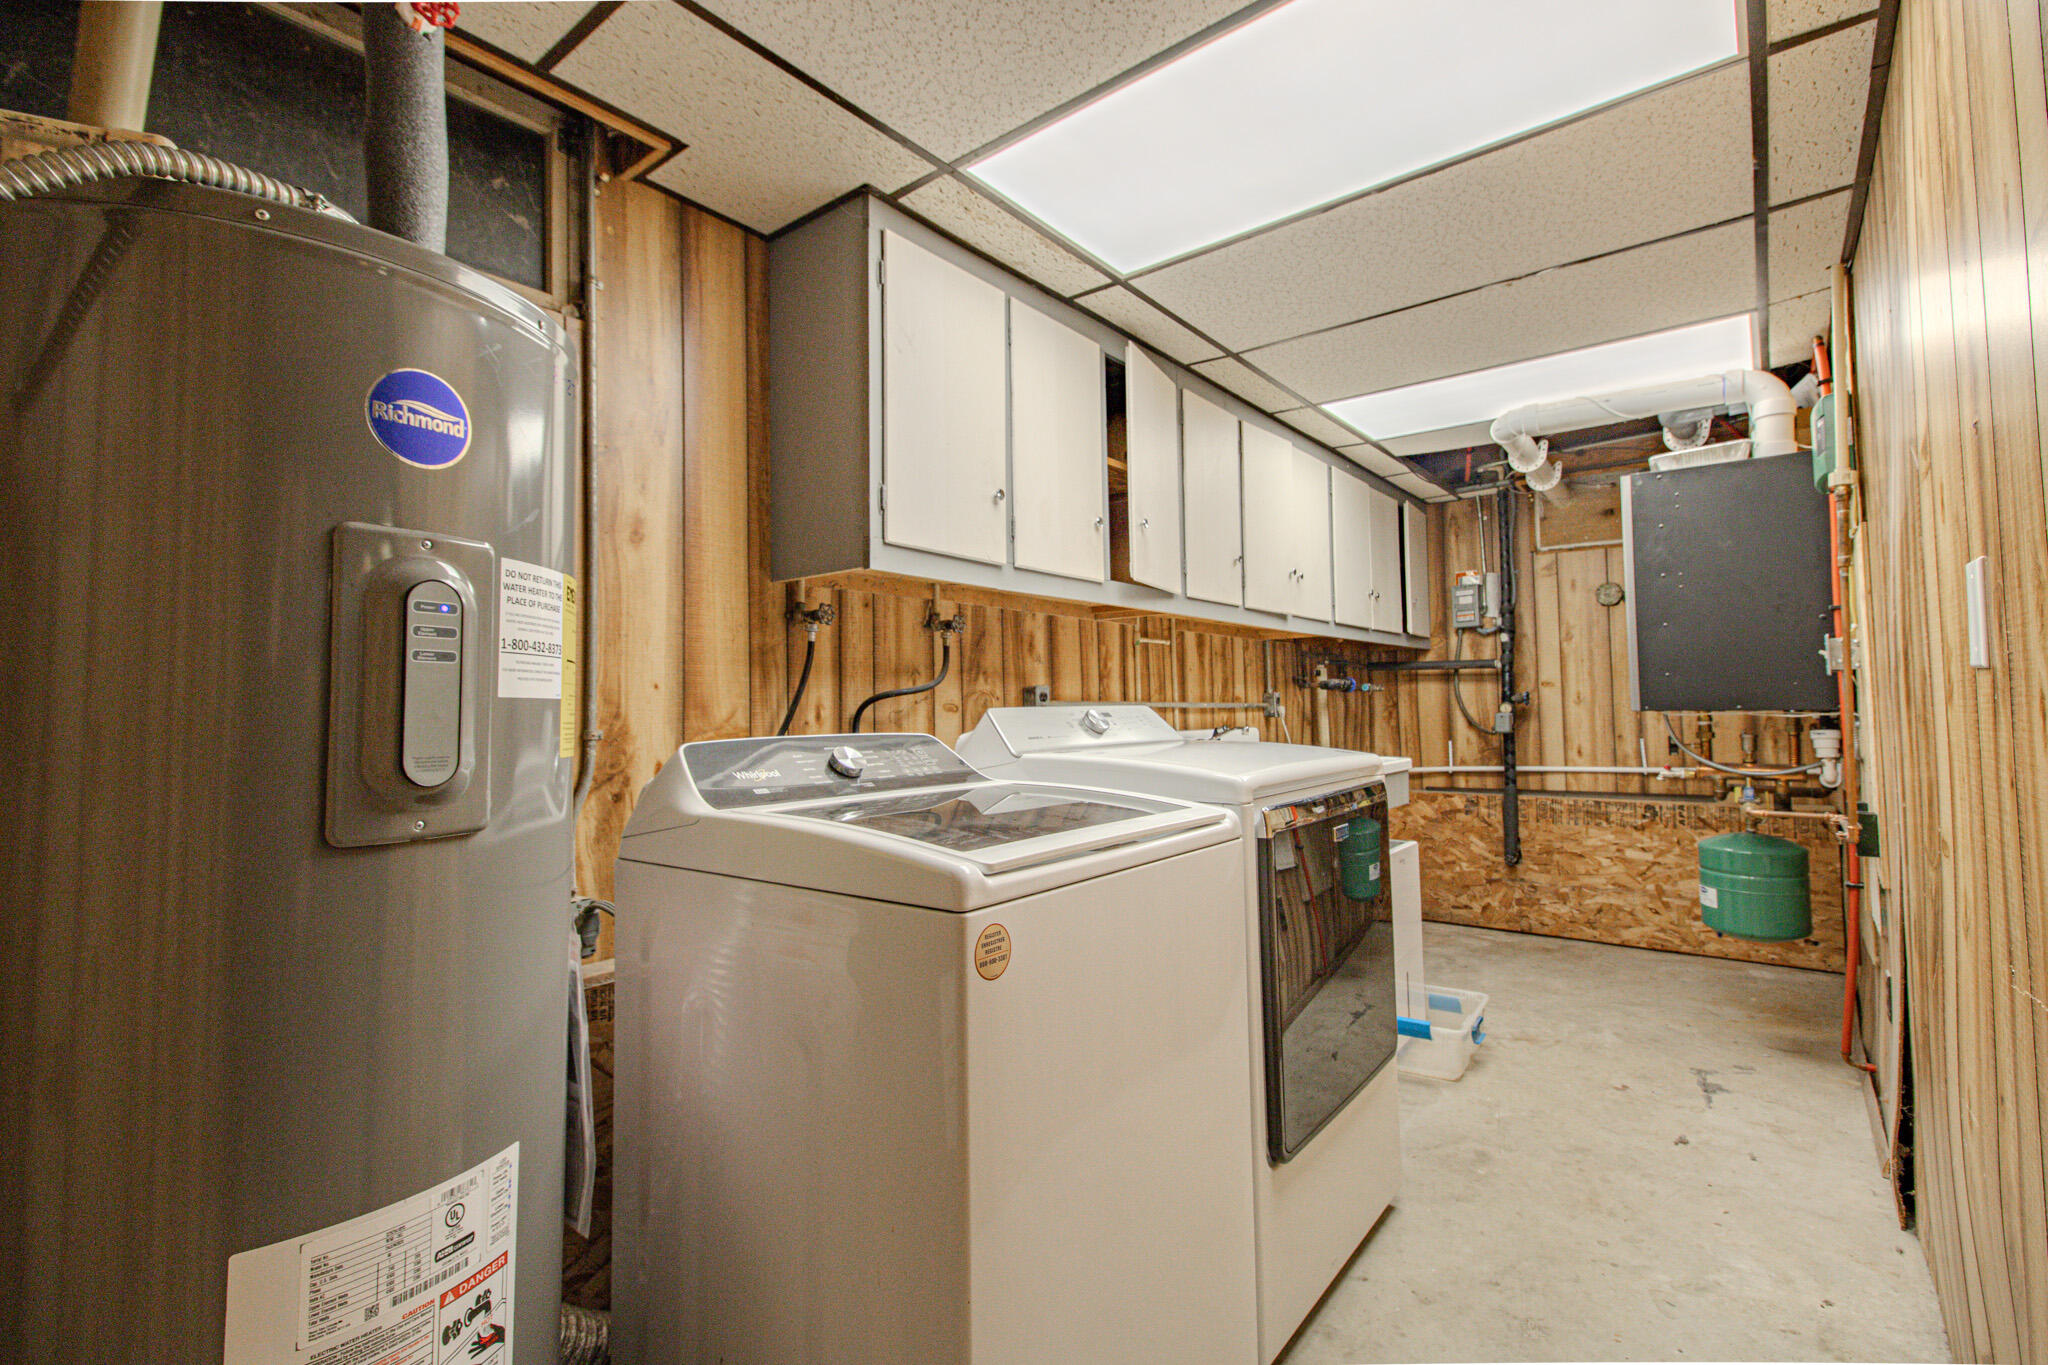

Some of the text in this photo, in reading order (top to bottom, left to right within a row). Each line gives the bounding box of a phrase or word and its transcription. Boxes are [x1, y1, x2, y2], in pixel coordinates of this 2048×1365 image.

[372, 400, 465, 438] Richmond
[505, 569, 517, 579] DO
[518, 571, 532, 581] NOT
[532, 574, 553, 586] RETURN
[503, 581, 527, 593] WATER
[528, 586, 548, 598] HEATER
[548, 591, 555, 600] TO
[506, 595, 527, 607] PLACE
[528, 599, 536, 608] OF
[501, 637, 562, 655] 1-800-432-8373
[731, 769, 782, 781] Whirlpool
[458, 1255, 505, 1295] DANGER
[401, 1298, 435, 1320] CAUTION
